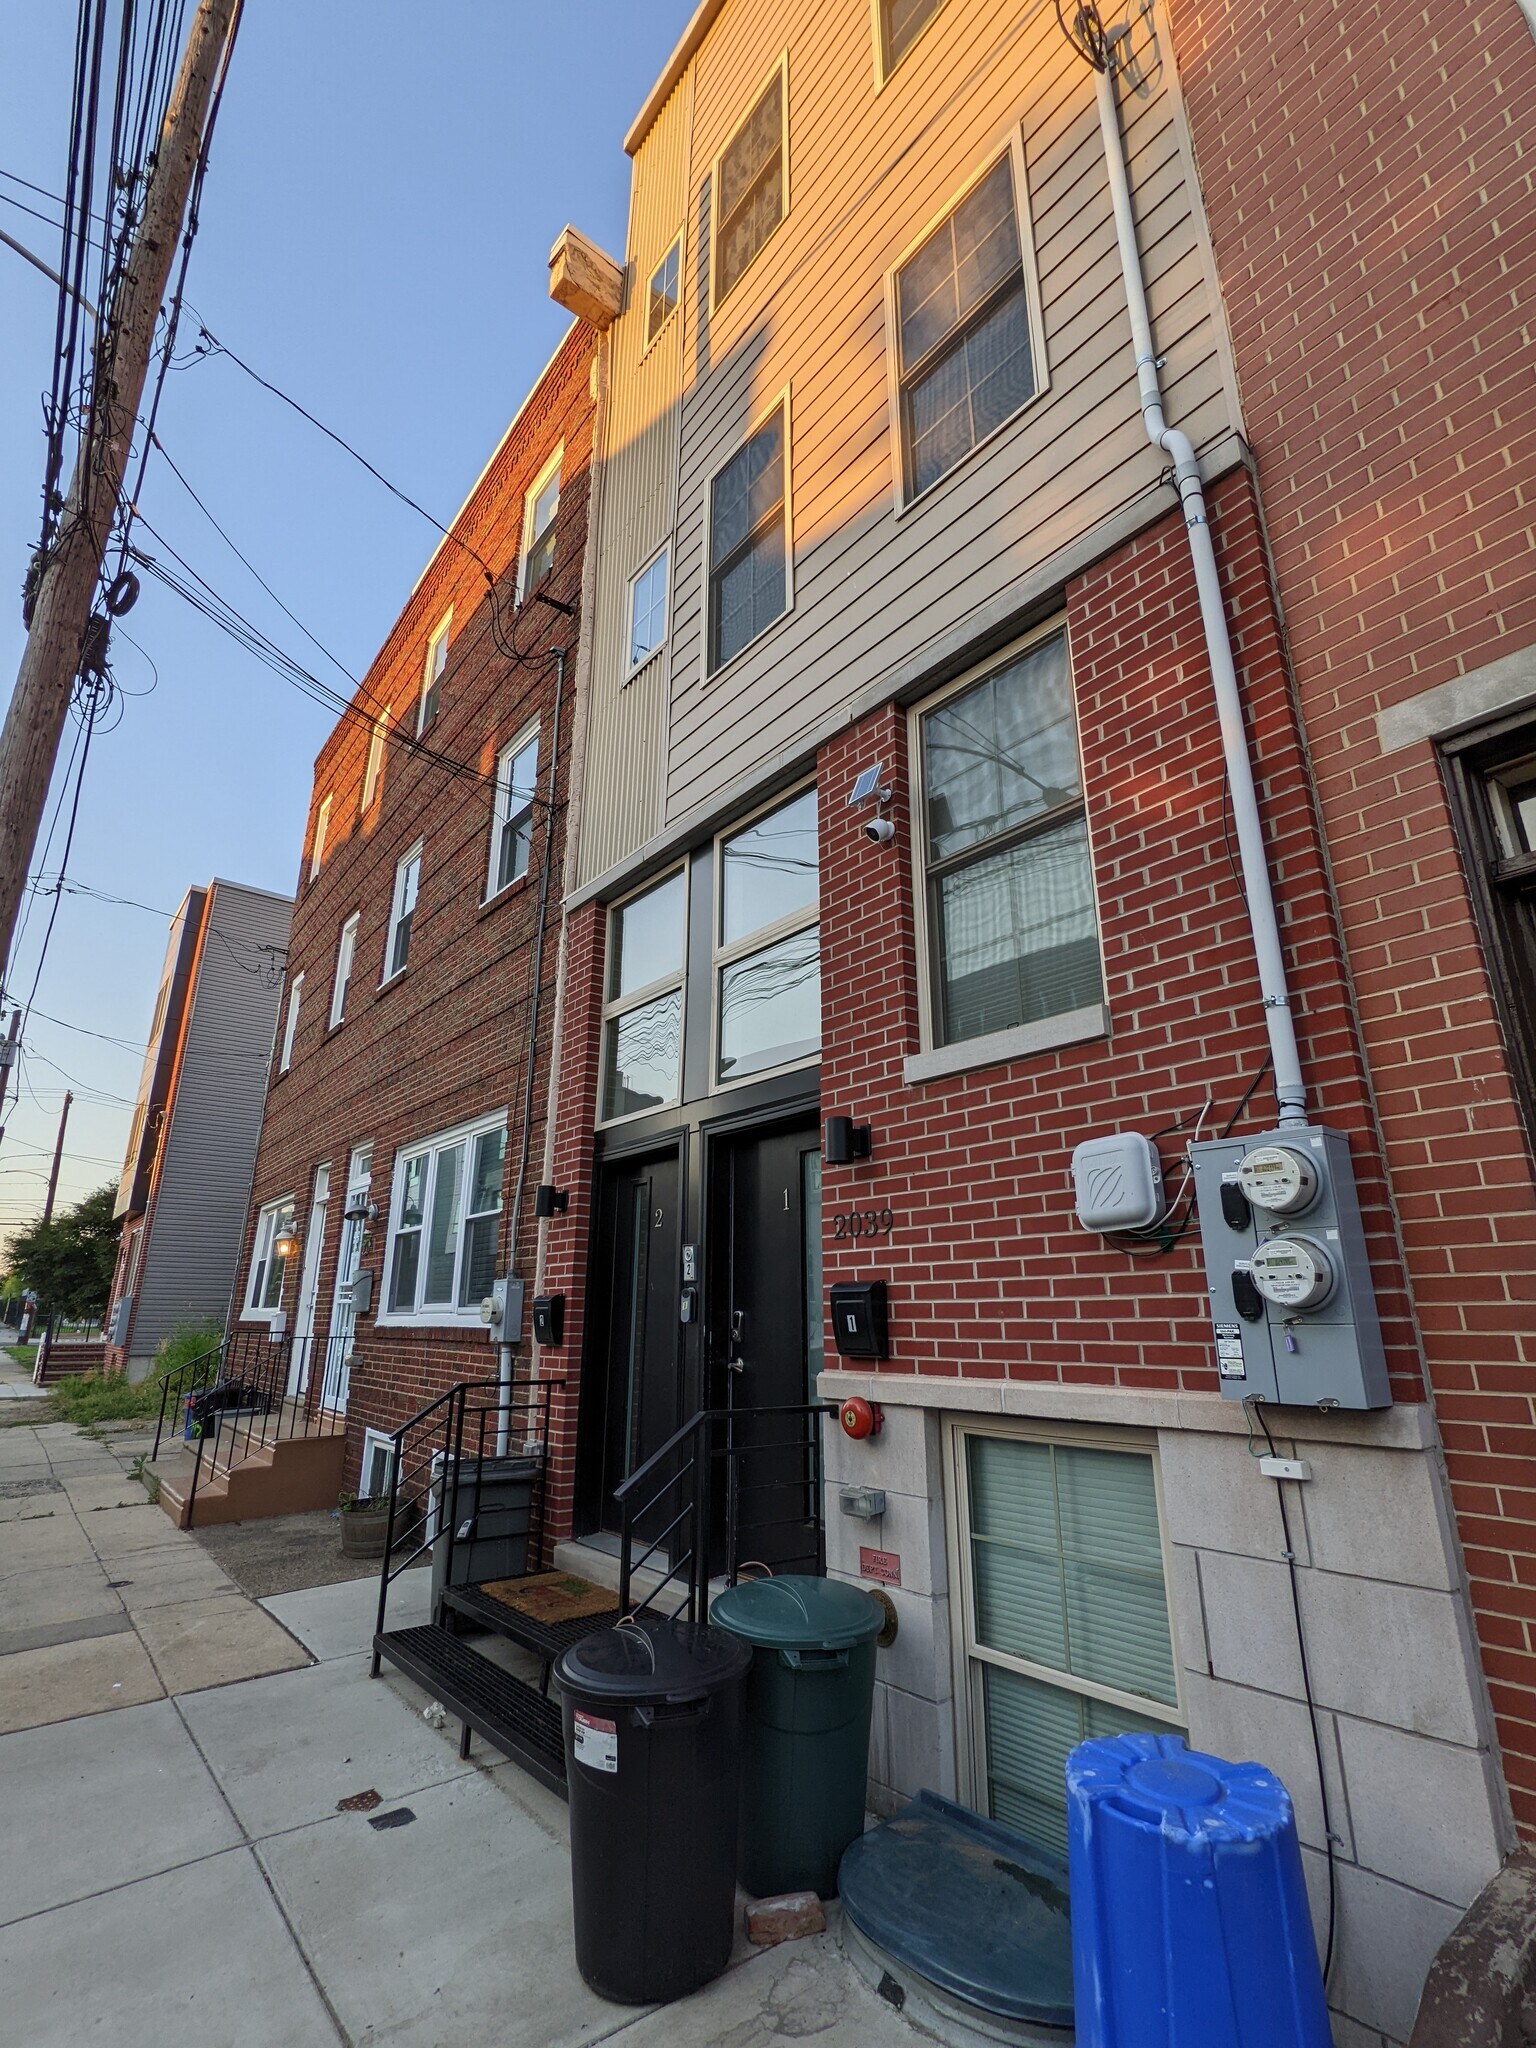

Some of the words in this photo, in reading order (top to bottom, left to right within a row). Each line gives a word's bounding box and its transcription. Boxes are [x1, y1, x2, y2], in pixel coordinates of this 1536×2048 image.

[783, 1188, 790, 1211] 1
[654, 1208, 663, 1228] 2
[833, 1208, 894, 1240] 2039
[686, 1263, 691, 1276] 2
[872, 1554, 888, 1566] FIRE
